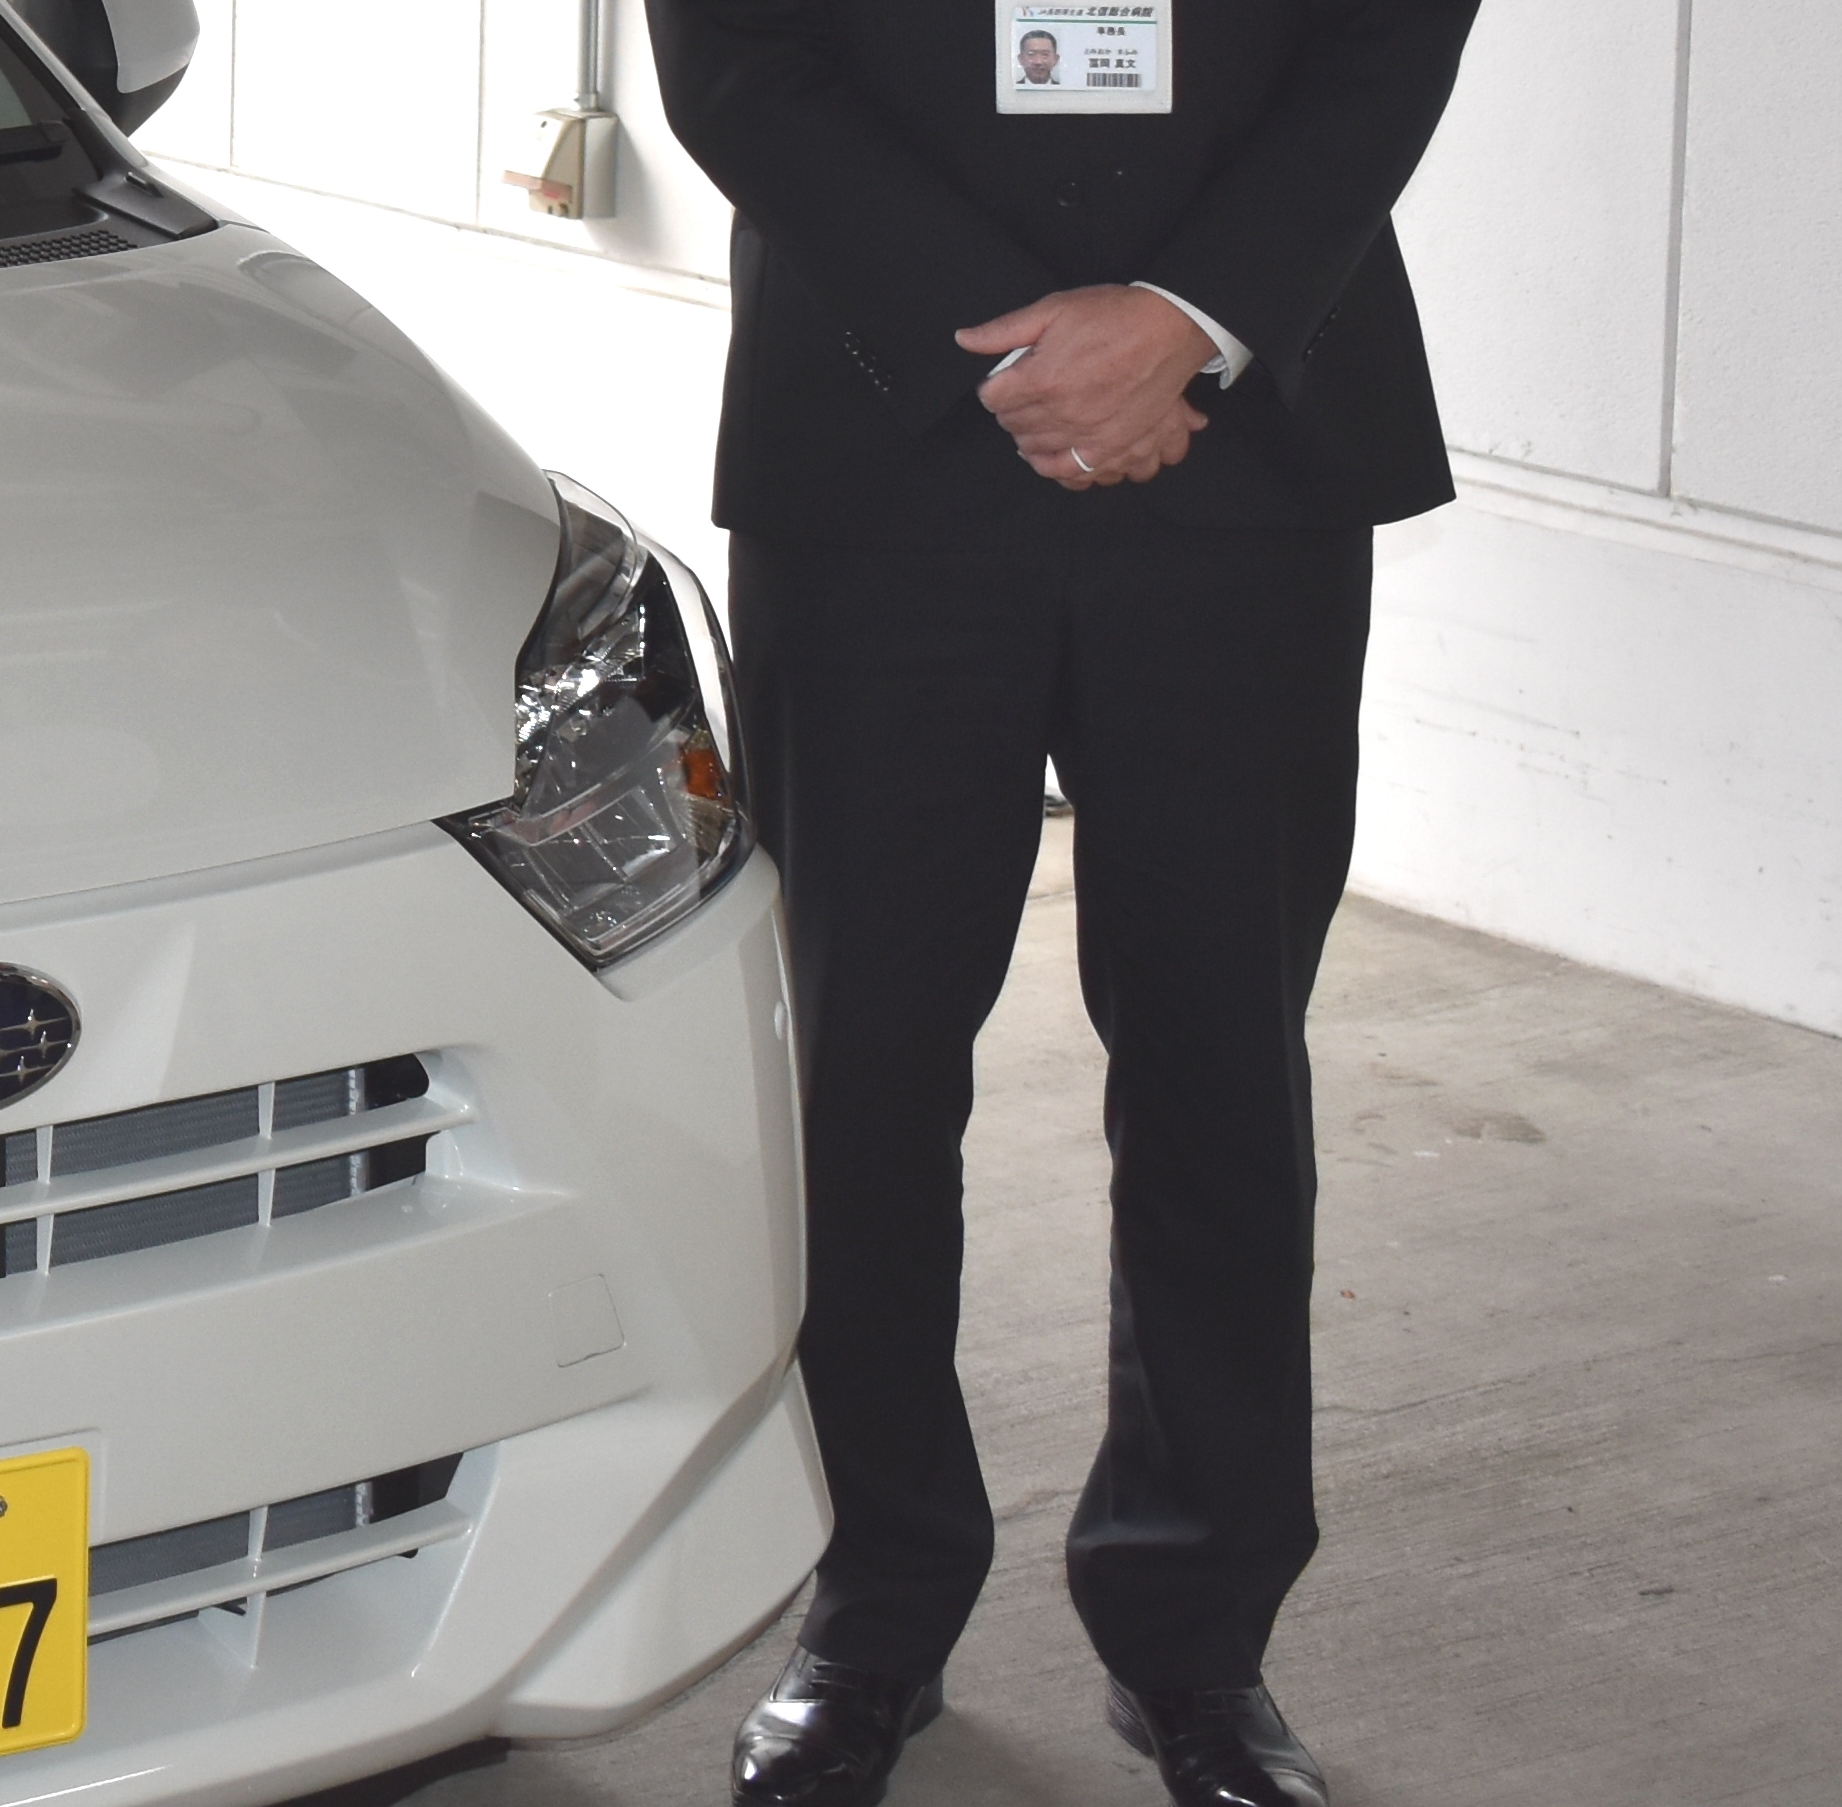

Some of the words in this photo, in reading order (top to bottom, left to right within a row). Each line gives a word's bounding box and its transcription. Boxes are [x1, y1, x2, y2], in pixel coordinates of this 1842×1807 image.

[1086, 6, 1154, 18] 北信総合病院
